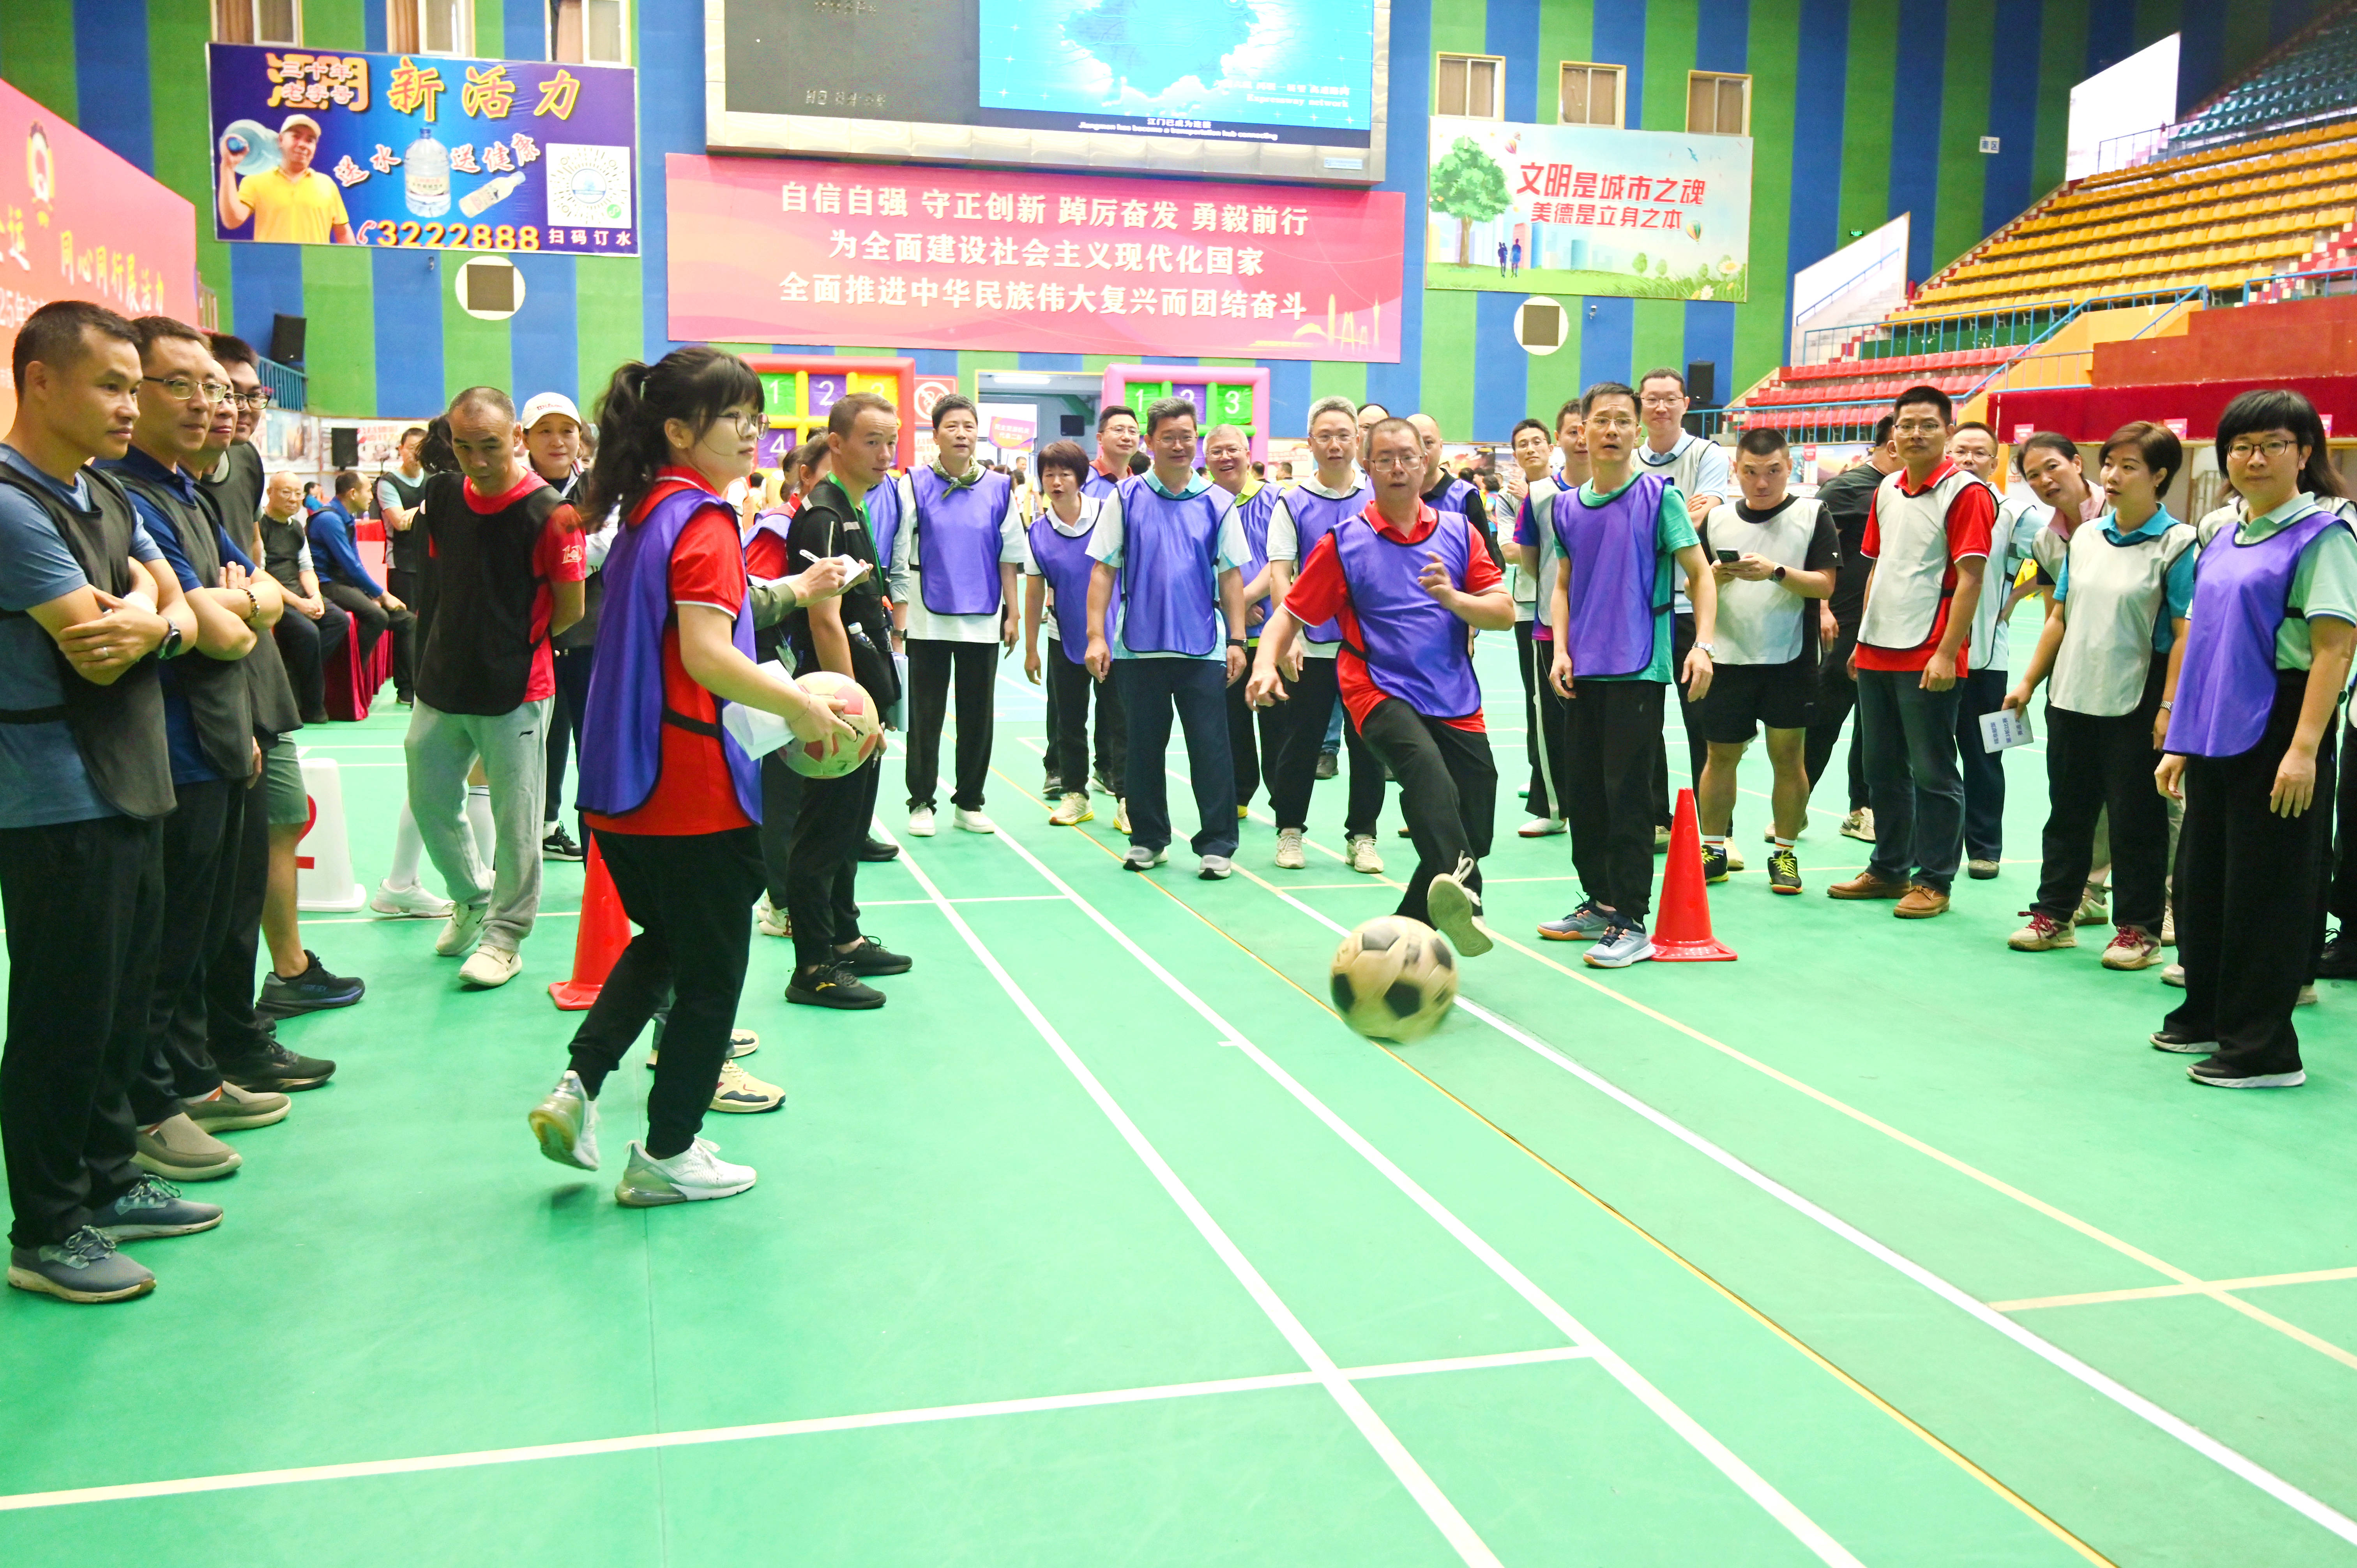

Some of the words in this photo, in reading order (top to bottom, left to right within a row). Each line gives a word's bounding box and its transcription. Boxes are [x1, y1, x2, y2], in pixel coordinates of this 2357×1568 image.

[279, 61, 354, 82] 三十年
[280, 82, 355, 105] 老字号
[387, 56, 580, 122] 新活力
[1247, 94, 1304, 106] Expressway
[1078, 122, 1116, 131] Jiangmen
[1133, 125, 1163, 133] become
[1171, 127, 1221, 136] transportation
[1237, 132, 1278, 141] connecting
[1147, 118, 1211, 129] 江门已成为连接
[333, 143, 401, 187] 送水
[450, 132, 541, 173] 送健康
[1516, 162, 1705, 205] 文明是城市之魂
[782, 181, 908, 217] 自信自强
[922, 189, 1046, 224] 守正创新
[1058, 196, 1178, 230] 踔厉奋发
[1192, 202, 1309, 236] 勇毅前行
[1531, 201, 1683, 230] 美德是立身之本
[376, 220, 539, 251] 3222888
[549, 228, 631, 246] 扫码订水
[829, 229, 1265, 276] 为全面建设社会主义现代化国家
[60, 230, 164, 316] 同心同行展活力
[780, 271, 1307, 321] 全面推进中华民族伟大复兴而团结奋斗
[769, 380, 779, 404] 1
[819, 381, 835, 406] 2
[1136, 389, 1143, 411] 1
[1225, 391, 1239, 414] 3
[770, 434, 786, 453] 4
